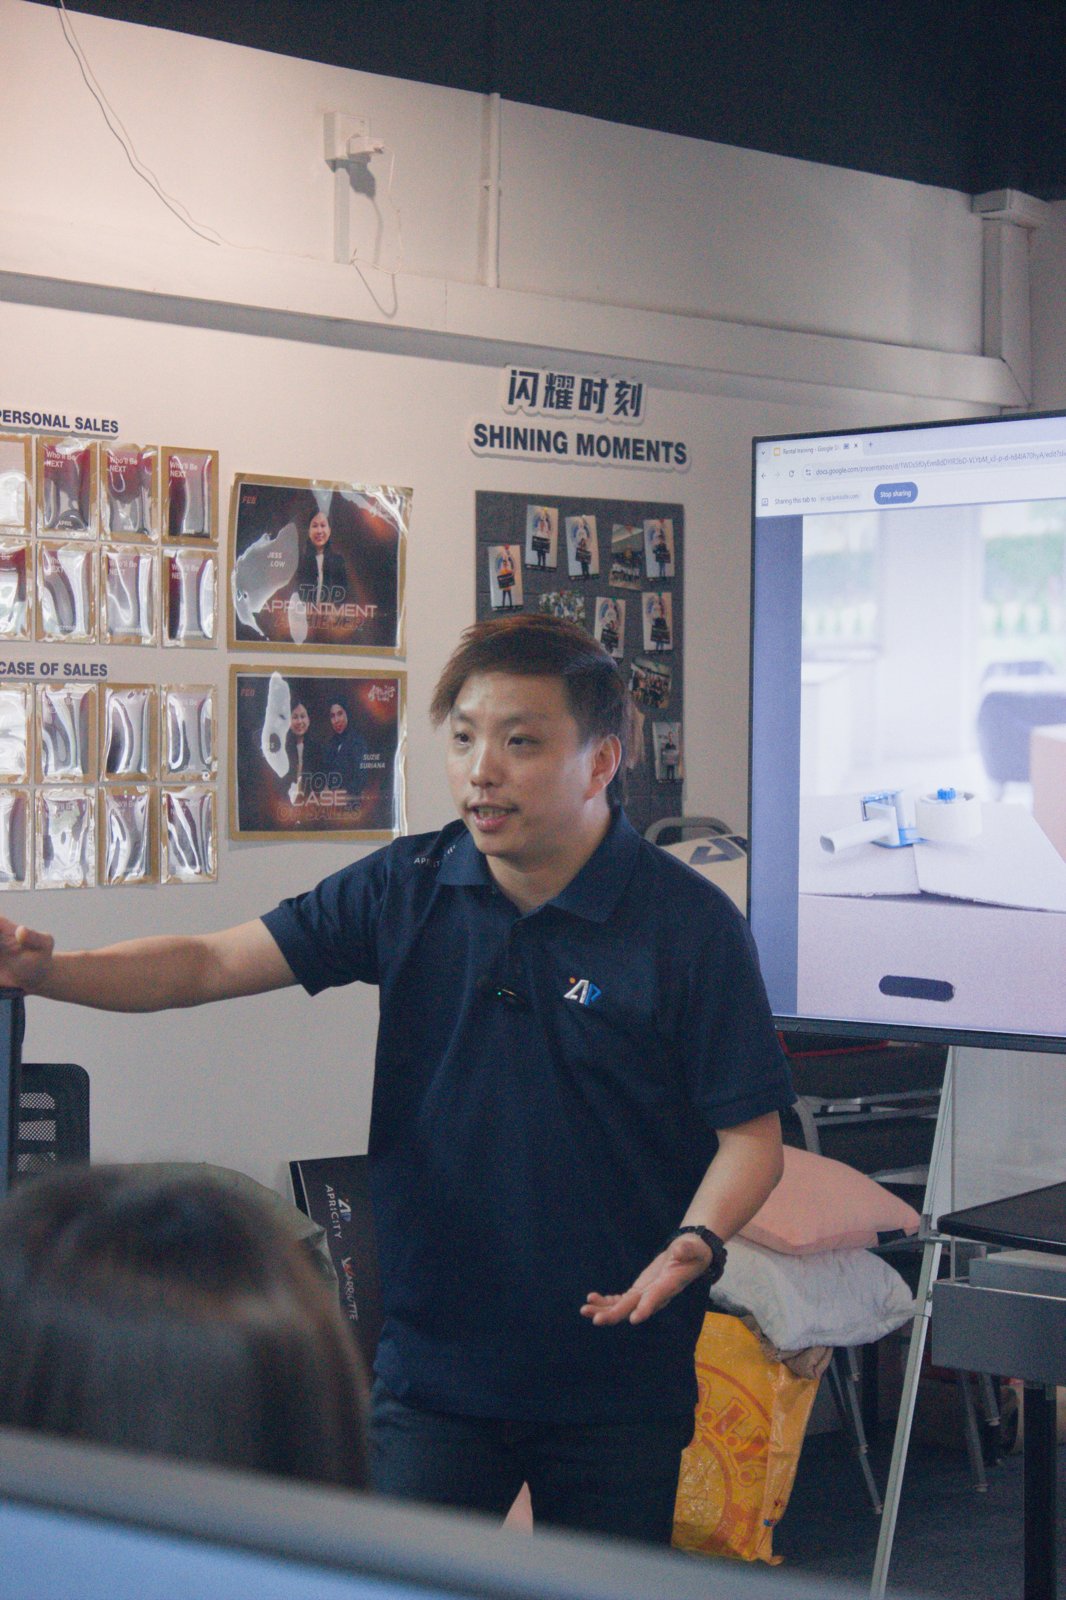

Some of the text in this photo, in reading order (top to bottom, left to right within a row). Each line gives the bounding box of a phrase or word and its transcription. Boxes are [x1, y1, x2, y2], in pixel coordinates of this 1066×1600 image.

[508, 370, 643, 417] 闪耀时刻
[0, 409, 119, 433] ERSONAL SALES
[474, 423, 687, 465] SHINING MOMENTS
[299, 584, 346, 603] TOP
[262, 600, 378, 618] APPOINTMENT
[40, 662, 59, 676] OF
[63, 663, 108, 677] SALES
[299, 771, 343, 789] TOP
[293, 790, 347, 807] CASE
[325, 1184, 343, 1239] APRICITY
